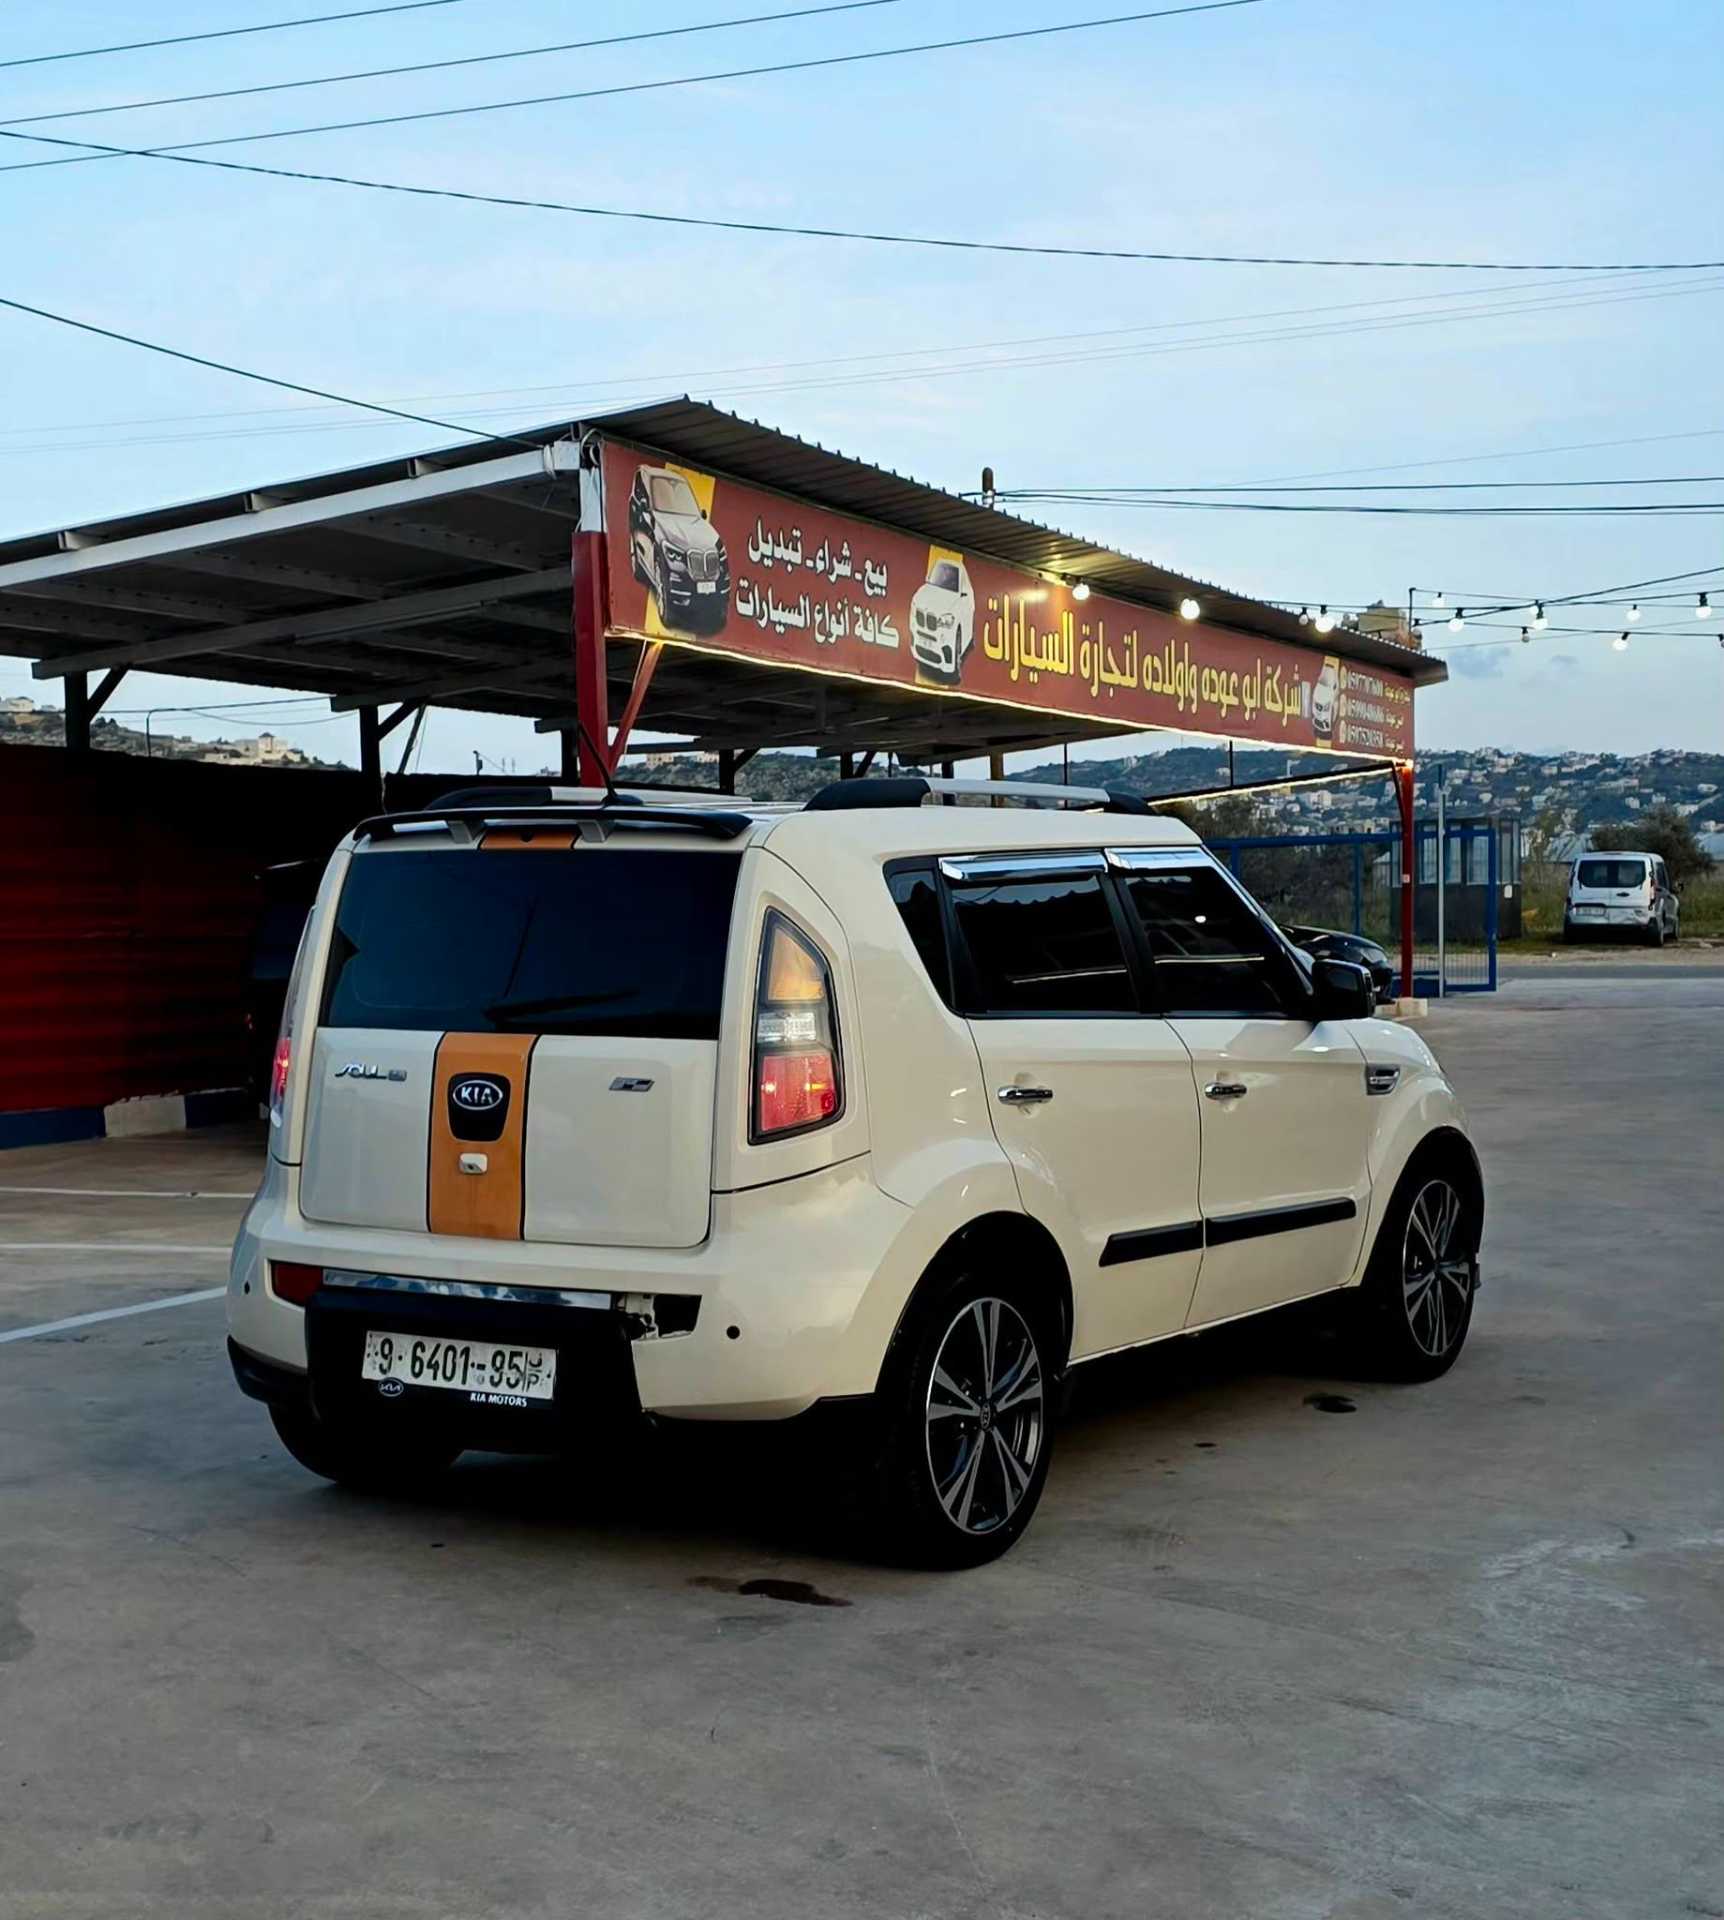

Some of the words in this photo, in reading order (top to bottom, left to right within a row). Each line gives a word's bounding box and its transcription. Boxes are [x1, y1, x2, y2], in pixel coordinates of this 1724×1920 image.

[748, 518, 803, 573] تبديل
[735, 577, 812, 635] السيارات
[814, 597, 850, 644] أنواع
[853, 604, 900, 648] كافة
[983, 594, 1075, 685] السيارات
[1080, 621, 1139, 697] لتجارة
[1241, 657, 1262, 721] ابو
[1265, 664, 1302, 727] شركة
[460, 1086, 494, 1105] KIA
[470, 1391, 487, 1403] KIA
[487, 1394, 528, 1408] MOTORS
